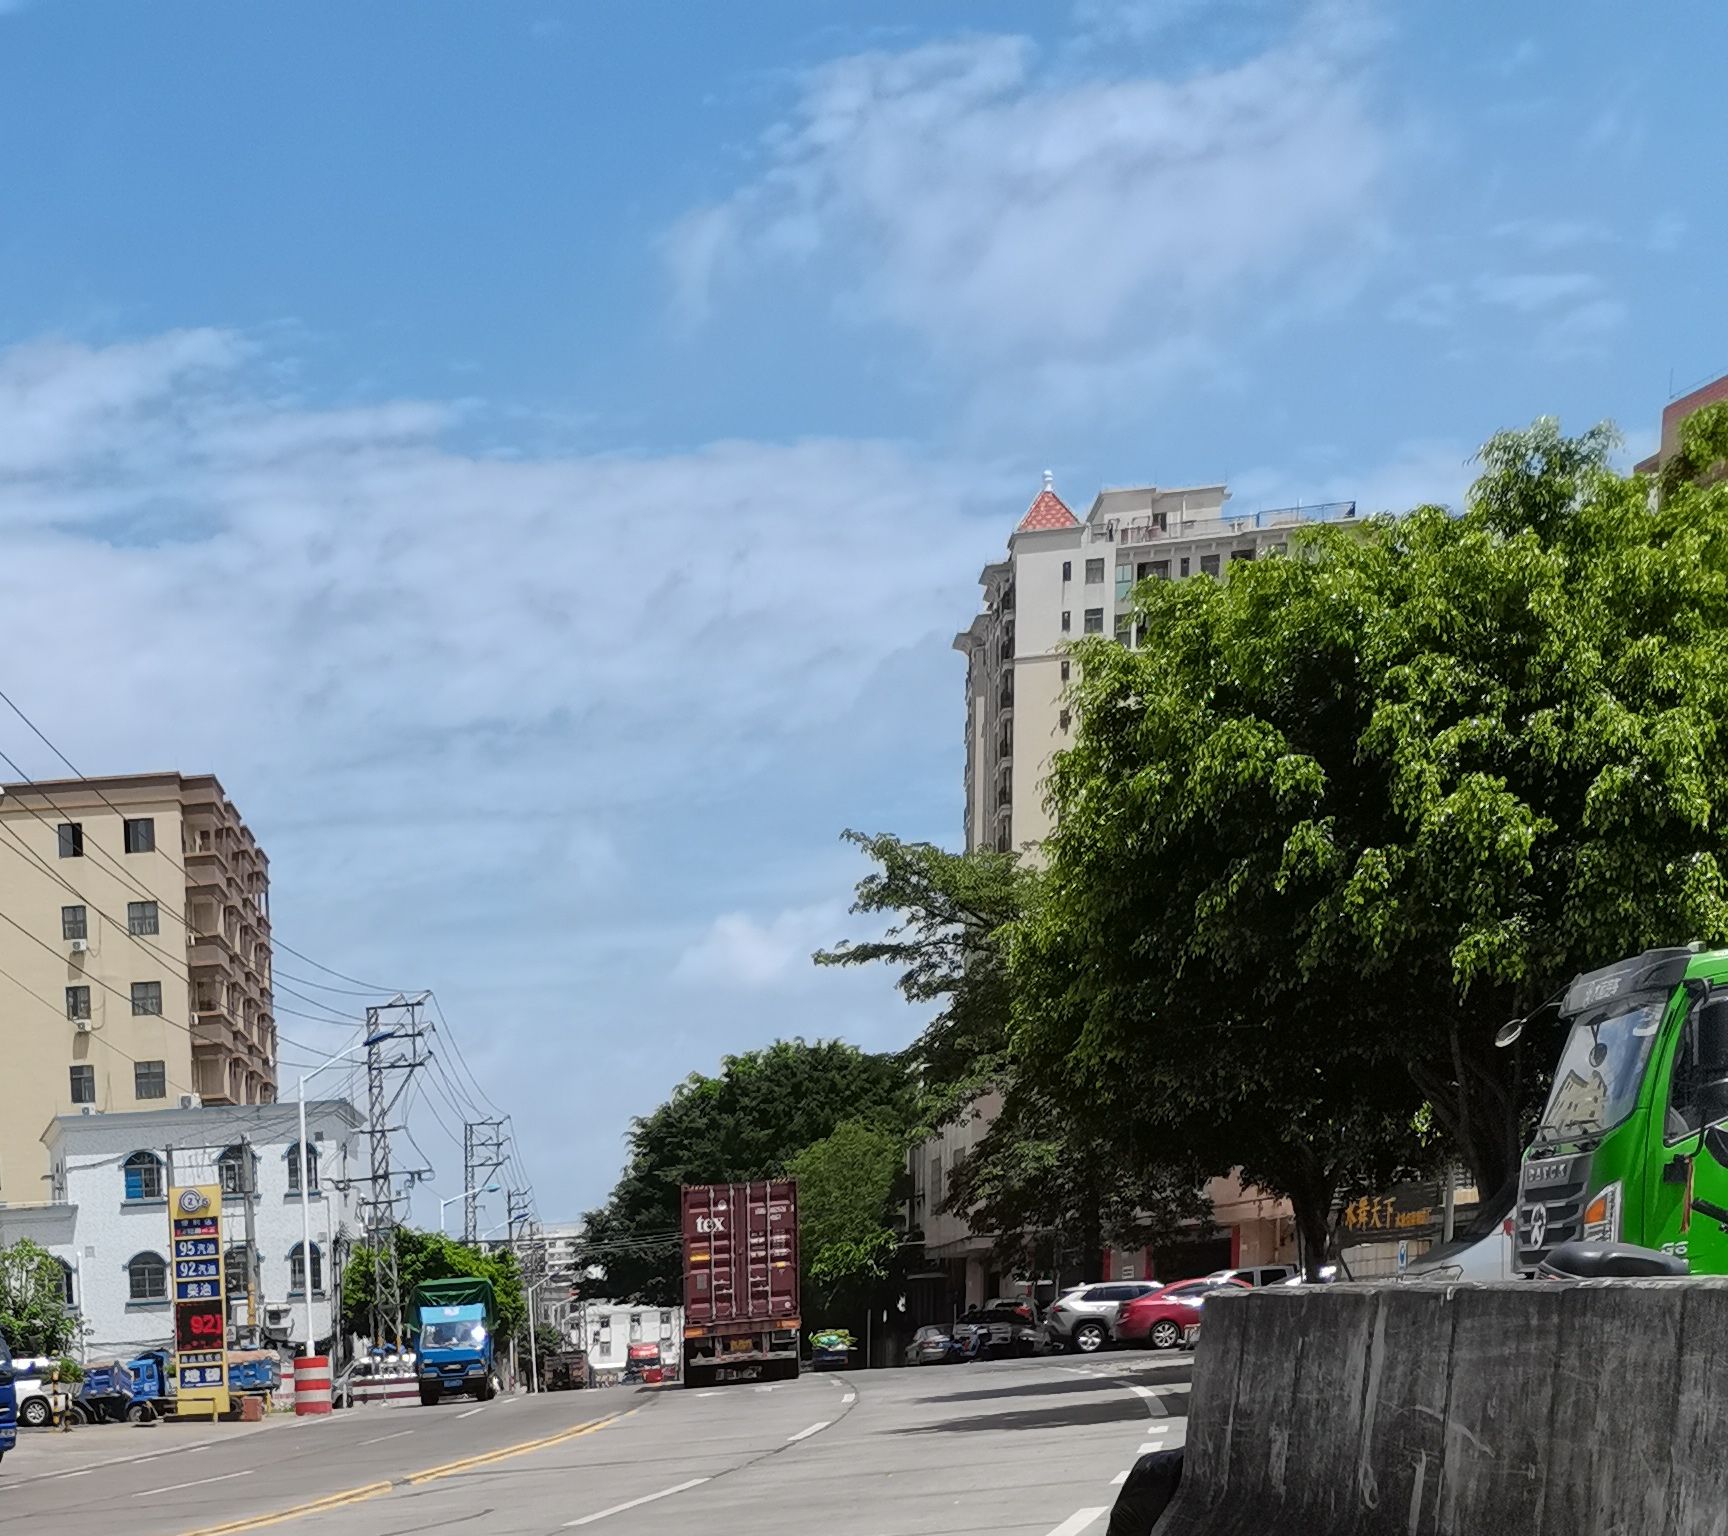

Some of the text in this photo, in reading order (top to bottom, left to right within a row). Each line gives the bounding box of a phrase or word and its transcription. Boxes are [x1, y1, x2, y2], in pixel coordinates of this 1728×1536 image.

[695, 1214, 726, 1233] tex
[179, 1240, 196, 1256] 95
[180, 1261, 197, 1277] 92
